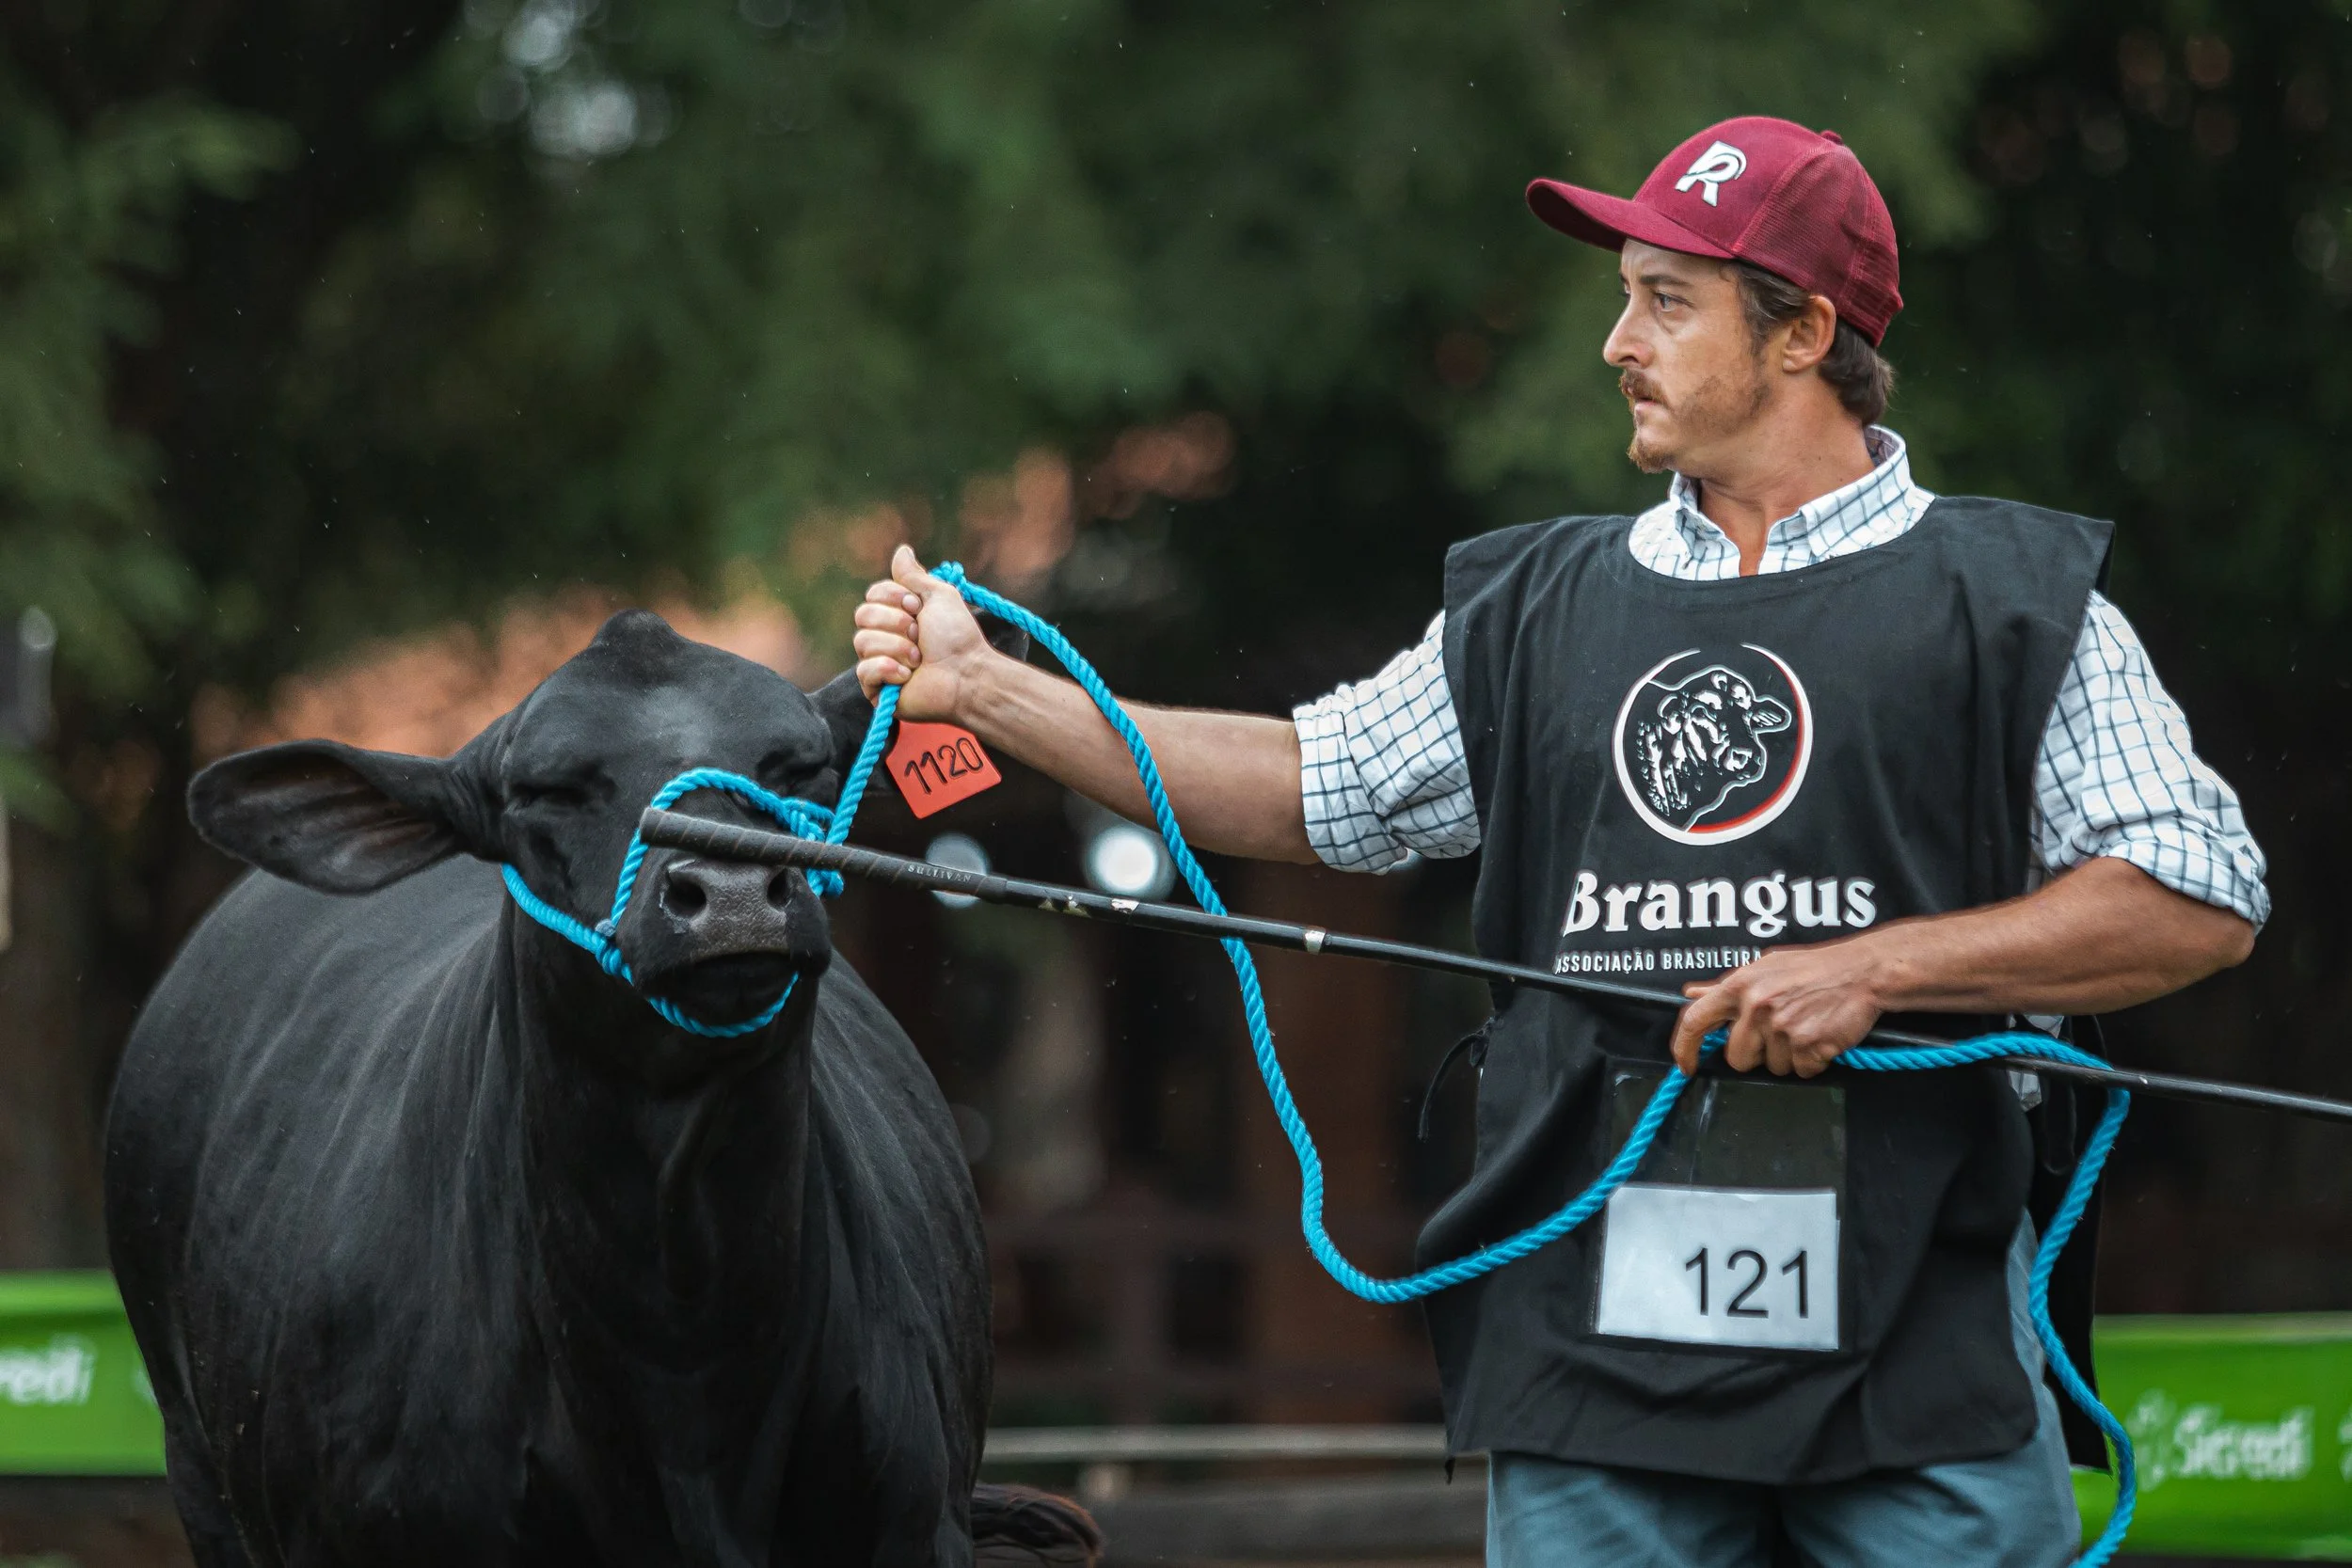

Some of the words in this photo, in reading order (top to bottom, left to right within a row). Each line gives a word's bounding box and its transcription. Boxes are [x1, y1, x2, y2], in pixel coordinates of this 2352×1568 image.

[904, 737, 983, 795] 1120
[907, 864, 971, 882] SULLIVAN
[1564, 870, 1876, 939] Brangus
[1684, 1246, 1809, 1320] 121
